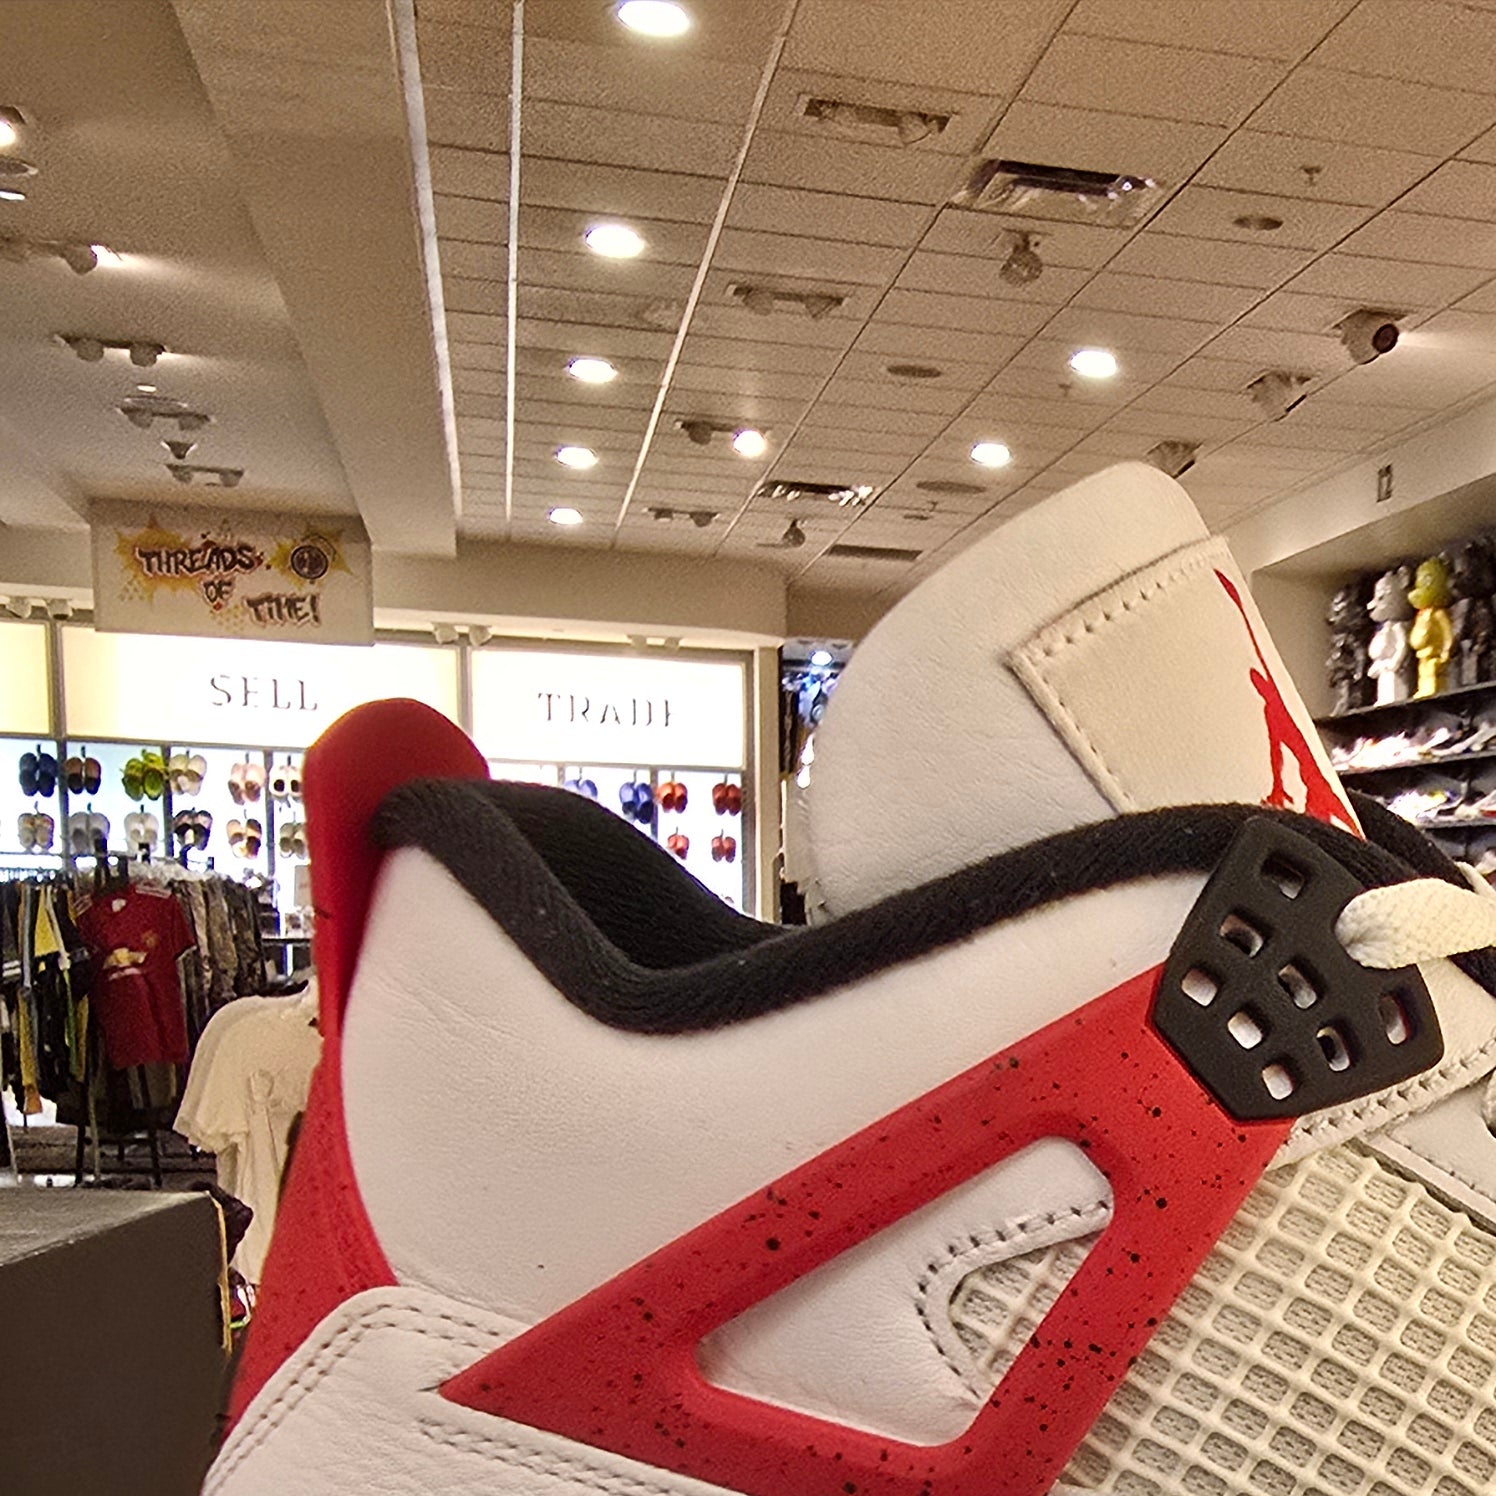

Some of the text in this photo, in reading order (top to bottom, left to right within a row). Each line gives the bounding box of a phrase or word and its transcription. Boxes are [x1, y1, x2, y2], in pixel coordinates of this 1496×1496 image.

[135, 544, 258, 576] THREADS
[202, 580, 233, 604] OF
[209, 674, 318, 711] SELL
[537, 692, 675, 727] TRADE
